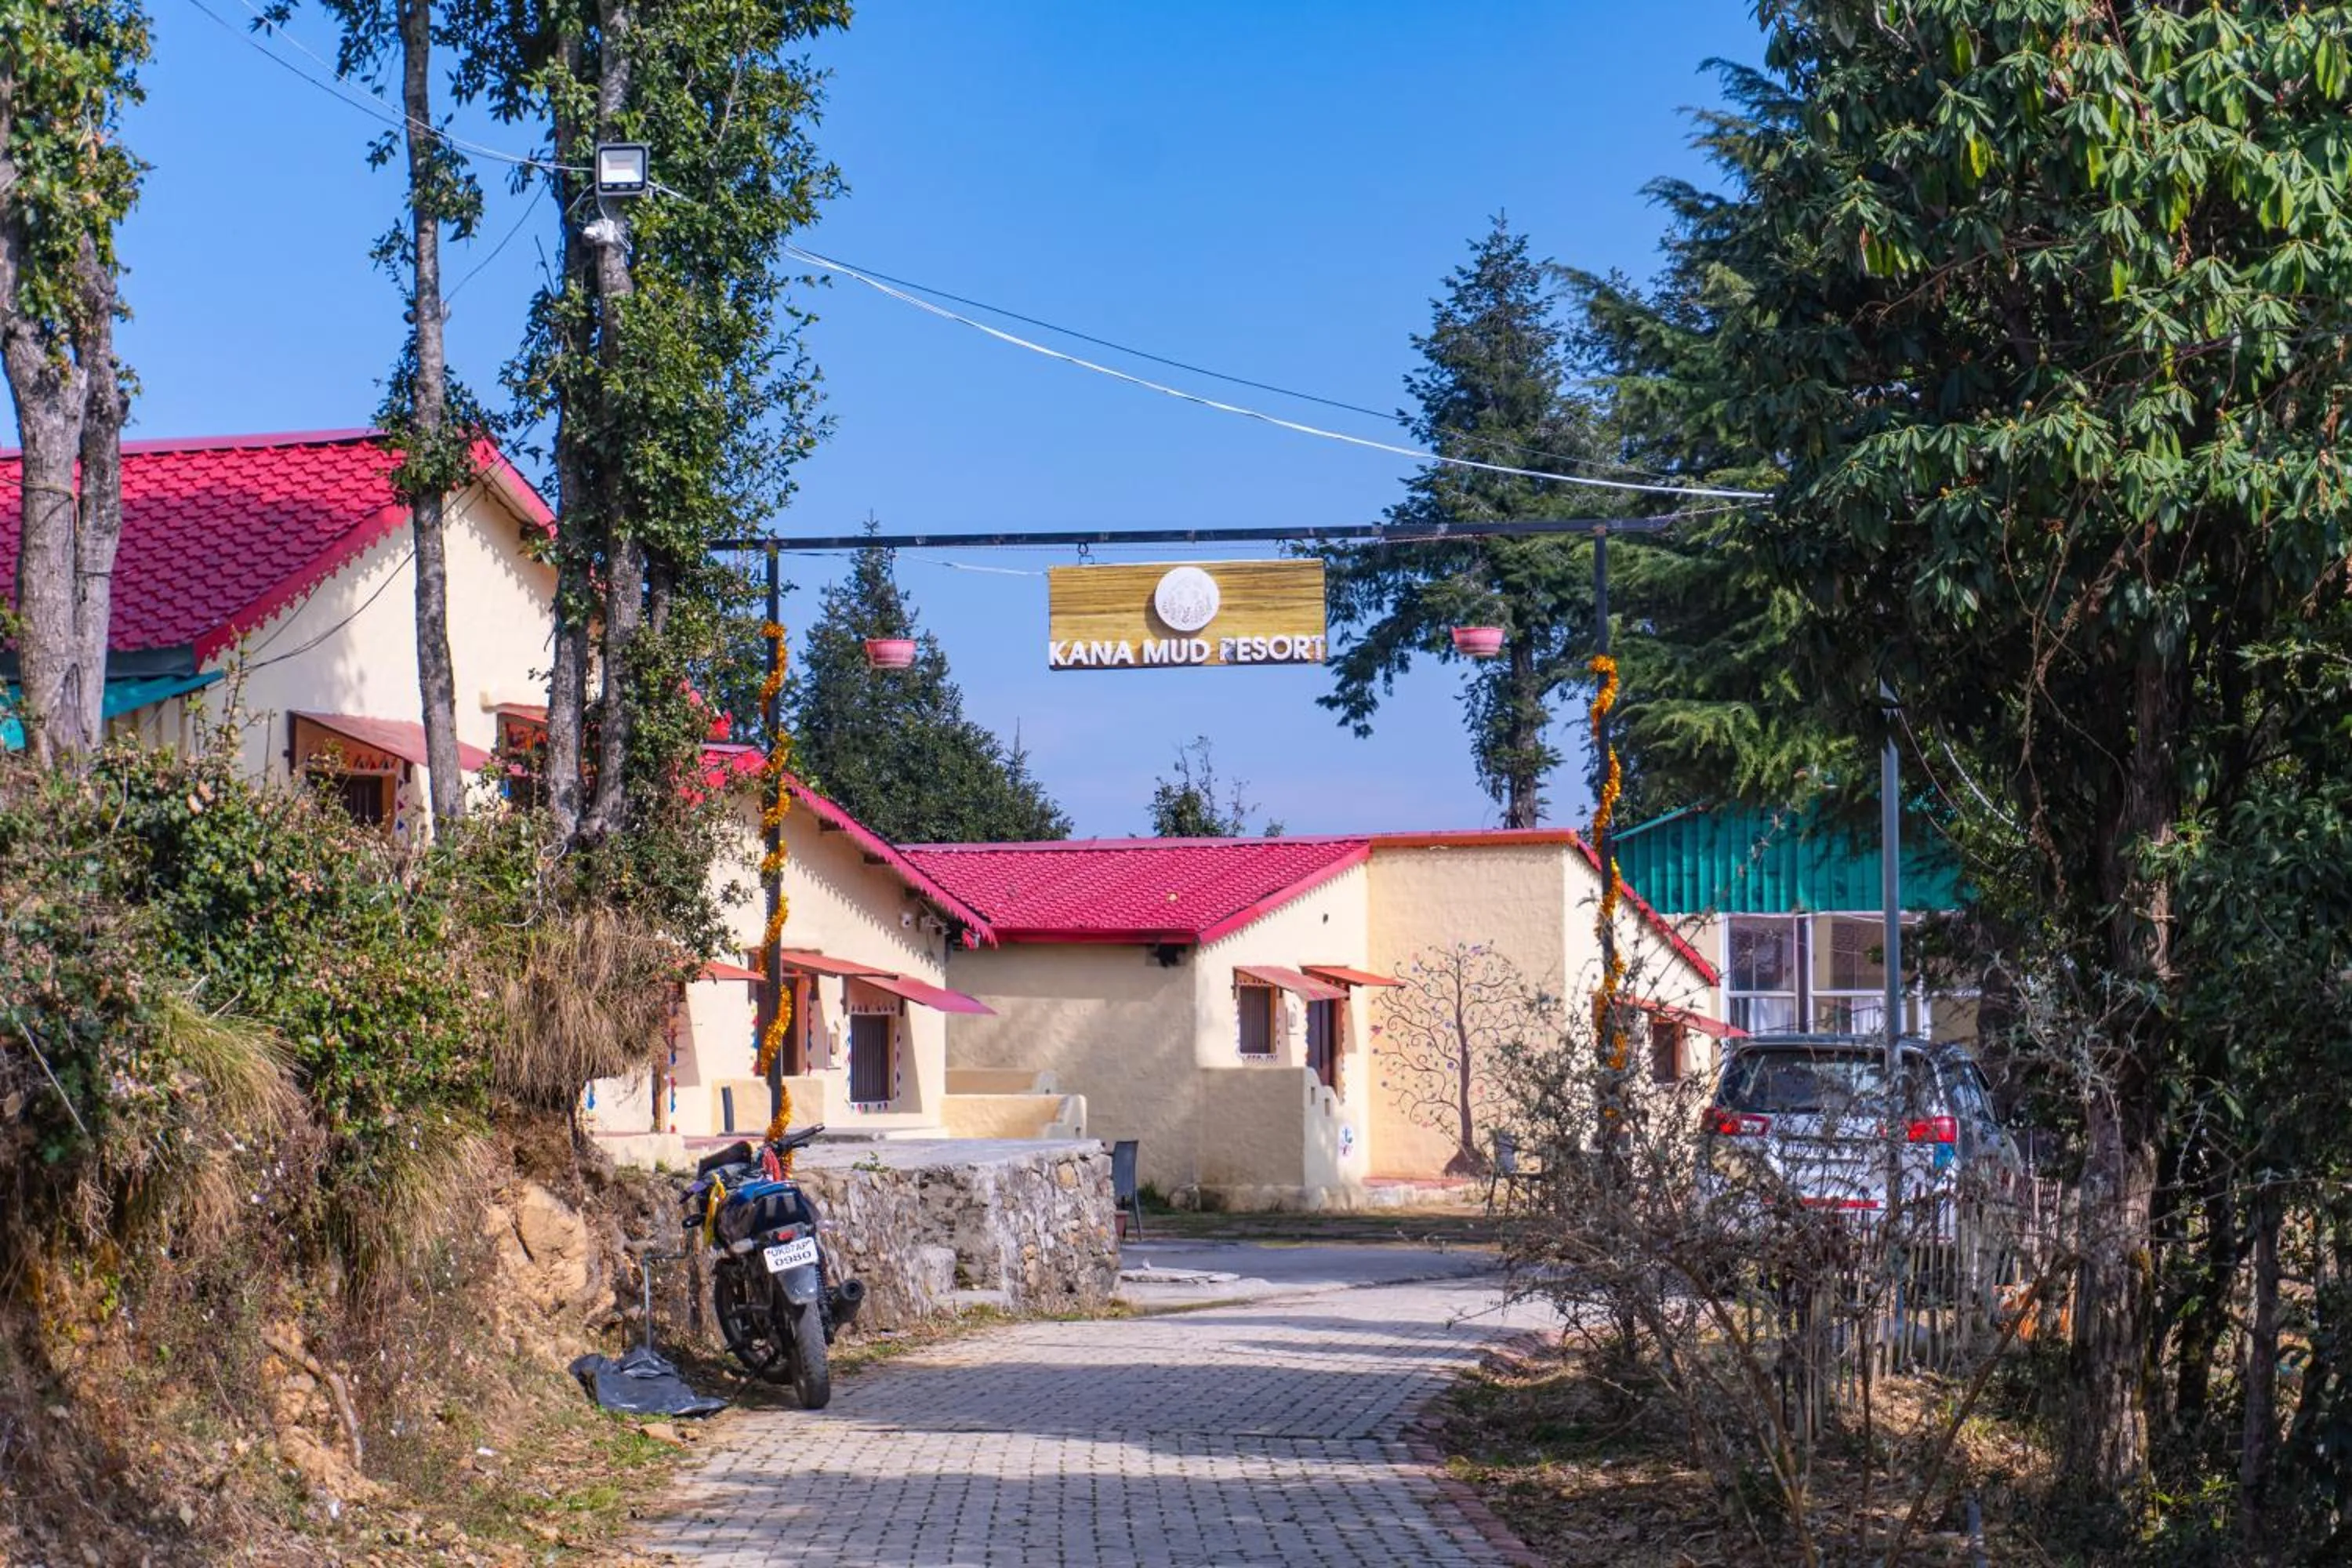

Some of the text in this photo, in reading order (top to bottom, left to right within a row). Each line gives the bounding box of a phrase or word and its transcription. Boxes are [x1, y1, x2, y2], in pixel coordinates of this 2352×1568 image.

[1049, 634, 1325, 665] KANA MUD RESORT
